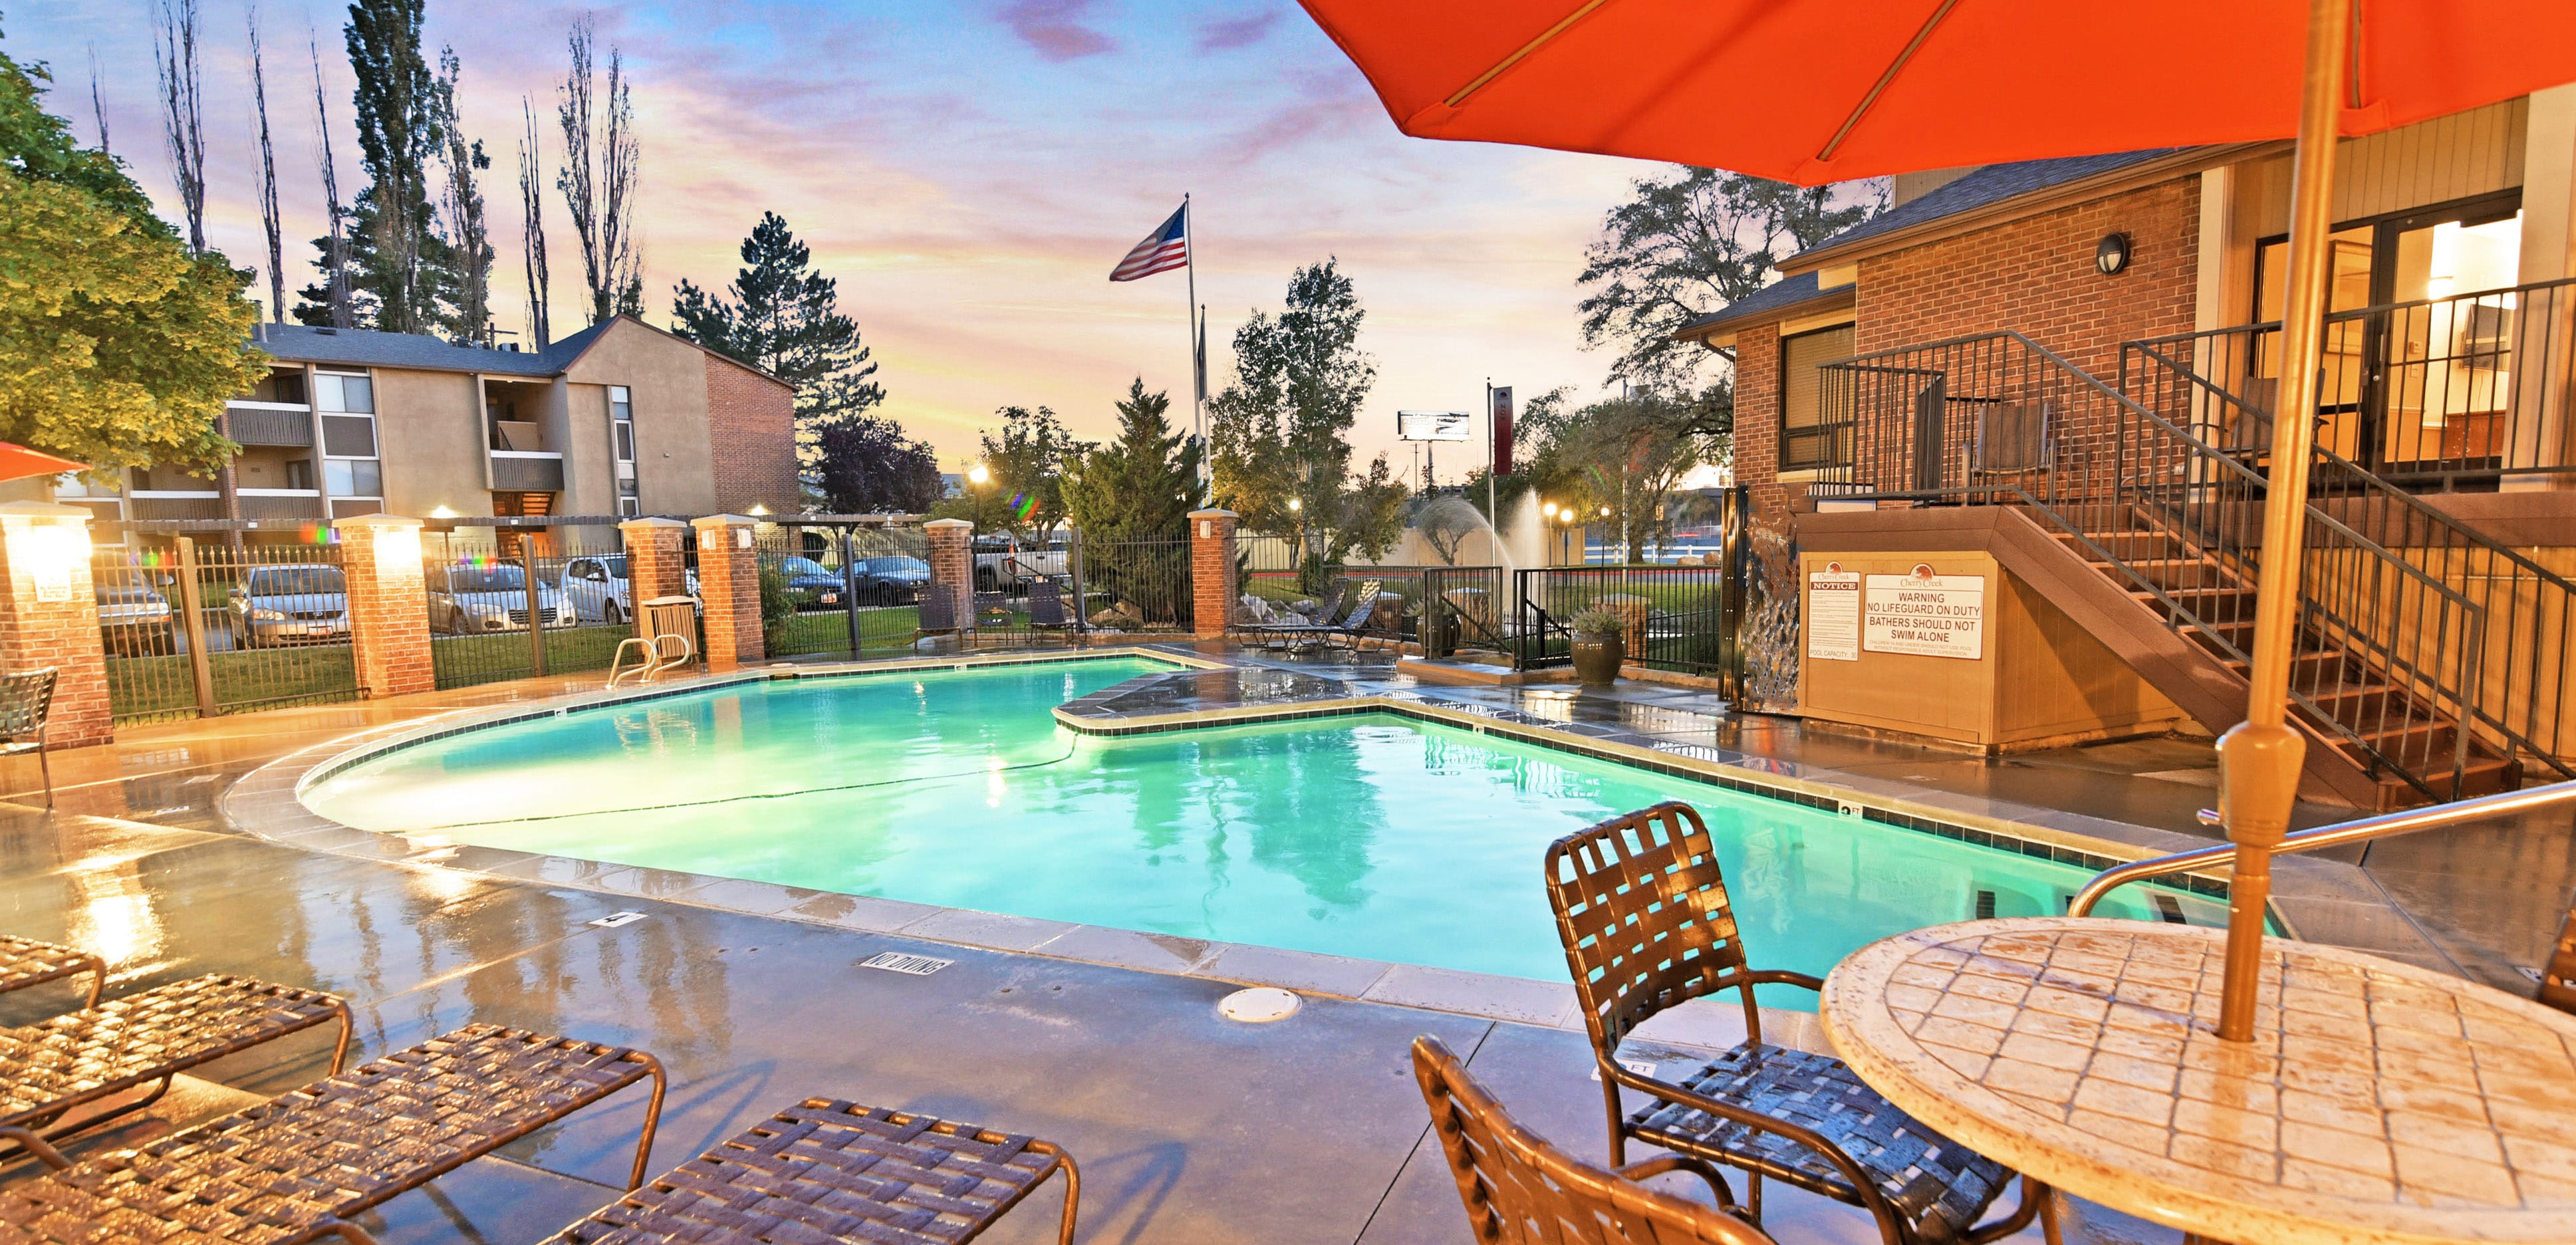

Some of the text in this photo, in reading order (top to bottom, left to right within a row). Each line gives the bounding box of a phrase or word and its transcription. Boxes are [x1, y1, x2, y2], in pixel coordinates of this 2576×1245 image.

[1900, 579, 1943, 587] Cherry Creek
[1898, 592, 1945, 603] WARNING
[1867, 603, 1980, 616] NO LIFEGUARD ON DUTY
[1869, 617, 1976, 631] BATHERS SHOULD NOT
[1891, 630, 1950, 642] SWIM ALONE
[864, 954, 946, 973] NO DIVING
